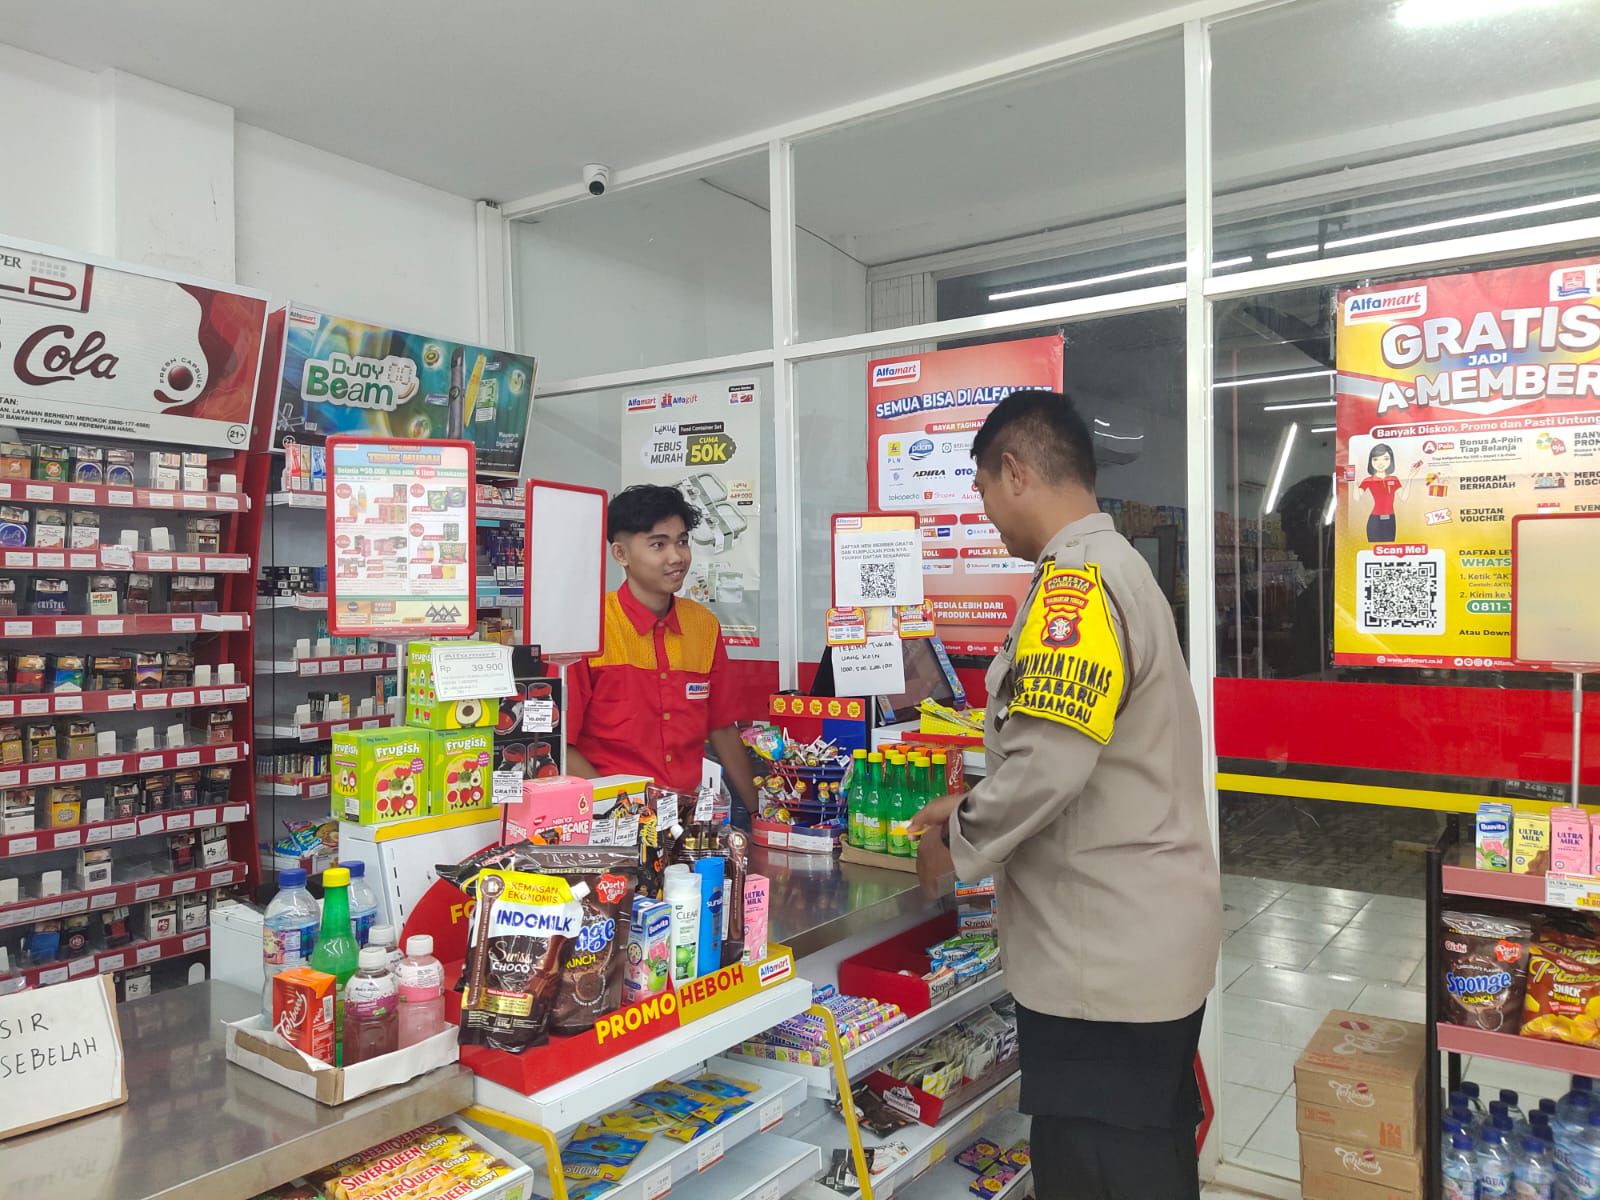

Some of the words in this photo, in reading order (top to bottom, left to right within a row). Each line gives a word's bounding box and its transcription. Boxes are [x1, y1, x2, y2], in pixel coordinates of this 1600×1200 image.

[1350, 290, 1421, 312] Alfamart
[1382, 305, 1600, 366] GRATIS
[13, 325, 120, 386] Cola
[1467, 352, 1507, 367] JADI
[159, 357, 177, 383] FRESH
[876, 364, 917, 377] Alfamart
[627, 396, 657, 408] Alfamart
[875, 398, 920, 418] SEMUA
[922, 393, 952, 409] BISA
[957, 390, 971, 404] DI
[12, 408, 43, 417] LAYANAN
[44, 411, 75, 421] BERHENTI
[76, 415, 107, 424] MEROKOK
[6, 414, 31, 422] BAWAH
[40, 417, 62, 426] TAHUN
[64, 420, 78, 428] DAN
[78, 421, 117, 432] PEREMPUAN
[932, 424, 956, 432] BAYAR
[1377, 427, 1416, 439] Banyak
[1461, 422, 1498, 433] Promo
[1500, 420, 1522, 429] dan
[1524, 416, 1555, 427] Pasti
[229, 430, 246, 440] 21+
[698, 436, 719, 444] CUMA
[1459, 439, 1488, 447] Bonus
[1488, 436, 1523, 445] A-Poin
[653, 441, 682, 453] TEBUS
[690, 443, 728, 463] 50K
[1459, 445, 1480, 455] Tiap
[1481, 443, 1517, 453] Belanja
[650, 452, 684, 465] MURAH
[912, 469, 946, 478] ADIRA
[954, 468, 973, 476] OTO
[1459, 474, 1507, 483] PROGRAM
[1459, 481, 1516, 490] BERHADIAH
[1459, 507, 1504, 515] KEJUTAN
[1459, 515, 1505, 523] VOUCHER
[1375, 545, 1403, 555] Scan
[1404, 544, 1426, 555] Me!
[1468, 572, 1491, 580] Ketik
[1459, 591, 1468, 599] 2.
[1469, 591, 1493, 599] Kirim
[1494, 591, 1505, 599] ke
[937, 611, 972, 620] PRODUK
[972, 611, 1007, 620] LAINNYA
[1458, 629, 1481, 637] Atau
[440, 665, 452, 673] Rp
[471, 663, 504, 672] 39.900
[1030, 677, 1099, 708] SABARU
[1023, 693, 1093, 724] SABANGAU
[334, 743, 359, 756] Frugish
[375, 742, 420, 758] Frugish
[446, 737, 488, 753] Frugish
[1518, 828, 1544, 837] ULTRA
[1521, 835, 1541, 843] MILK
[1557, 831, 1584, 840] ULTRA
[1560, 838, 1581, 846] MILK
[510, 881, 559, 895] KEMASAN
[507, 890, 559, 904] EKONOMIS
[744, 890, 765, 900] ULTRA
[746, 896, 763, 905] MILK
[496, 909, 574, 932] INDOMILK
[676, 910, 699, 920] CLEAR
[494, 940, 533, 964] Swiss
[491, 961, 531, 974] CHOCO
[759, 958, 789, 977] Alfamart
[1446, 972, 1512, 997] Sponge
[1553, 983, 1583, 997] SNACK
[595, 992, 677, 1045] PROMO
[679, 964, 745, 1008] HEBOH
[0, 1036, 97, 1079] SEBELAH
[339, 1145, 424, 1192] SILVERQUEEN
[420, 1136, 449, 1151] Crispy
[442, 1153, 472, 1169] Crispy
[469, 1169, 498, 1188] Crispy
